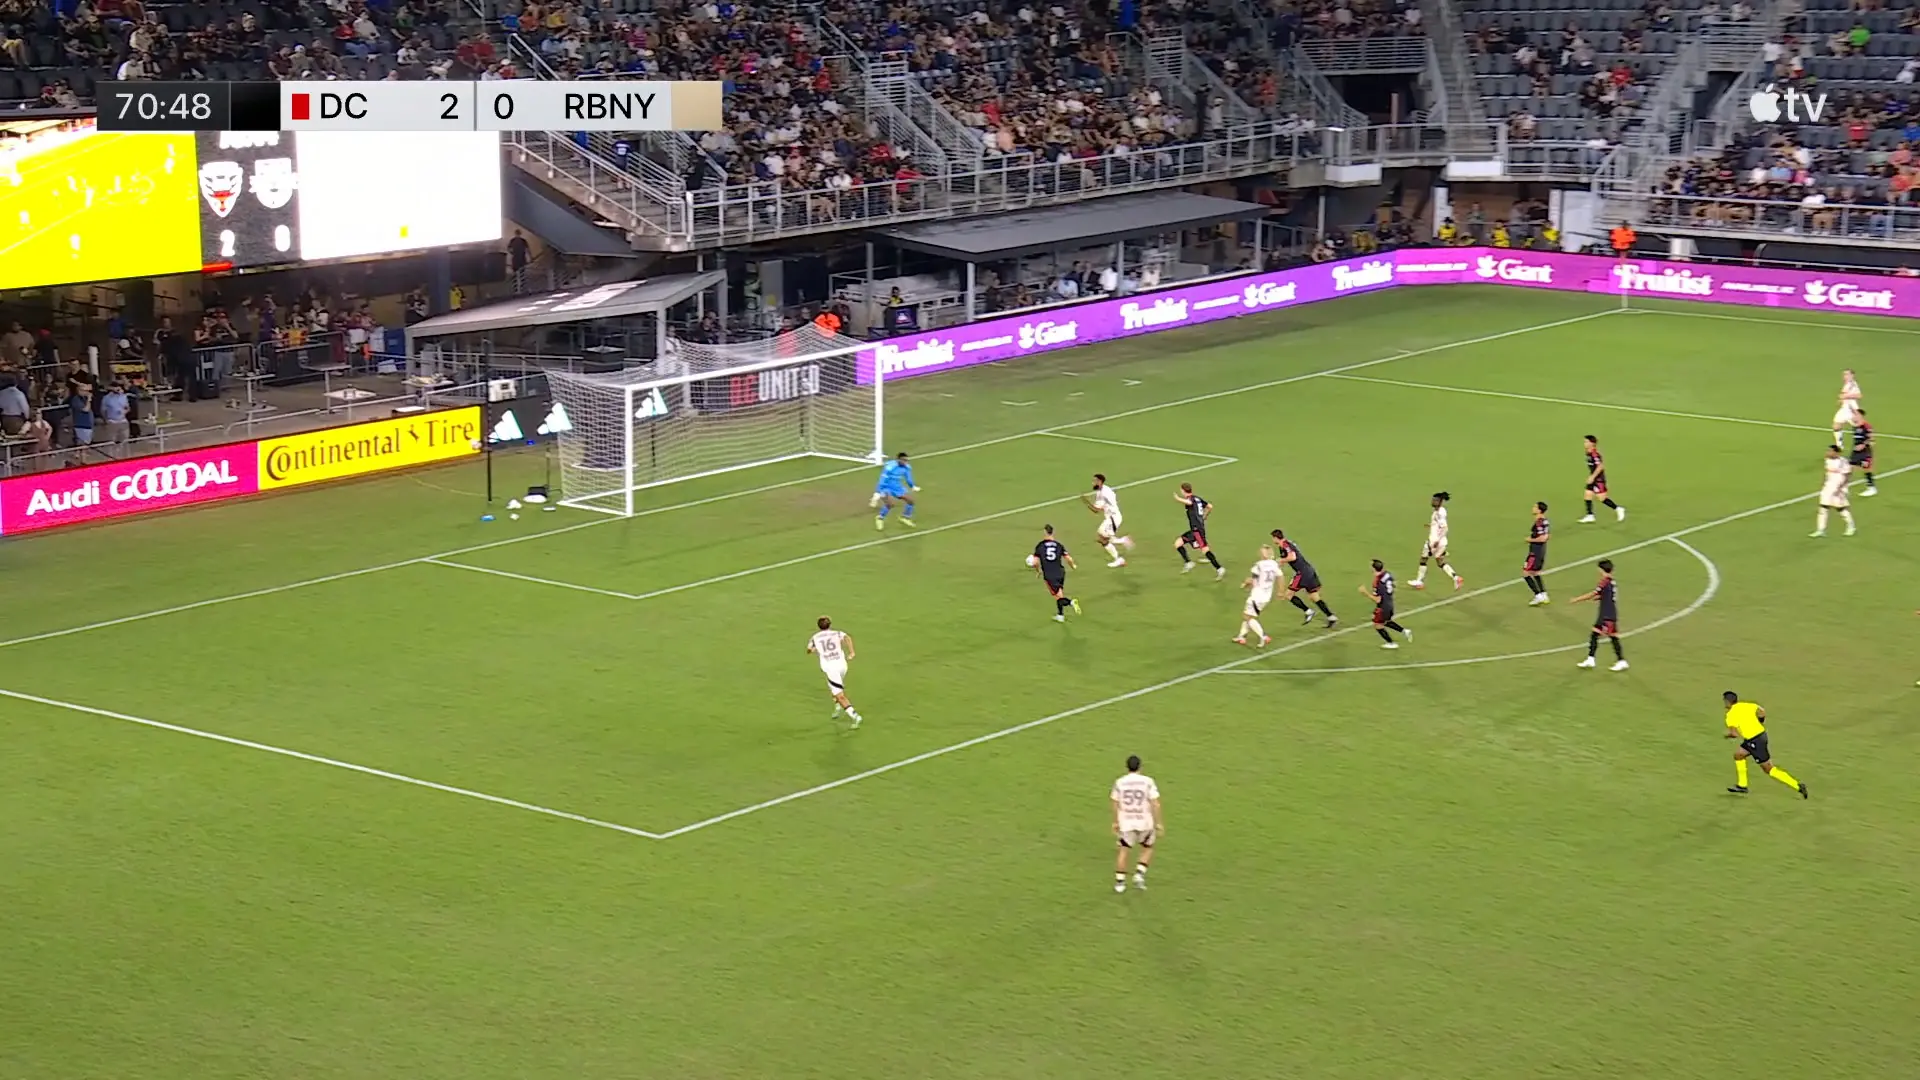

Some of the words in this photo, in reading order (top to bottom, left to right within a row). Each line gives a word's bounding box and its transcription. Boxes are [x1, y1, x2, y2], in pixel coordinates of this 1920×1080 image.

[220, 229, 236, 257] 2
[1498, 258, 1554, 283] Giant
[1612, 264, 1714, 295] Fruitist
[1827, 282, 1896, 309] Giant
[758, 364, 820, 402] UNITED
[266, 427, 401, 481] Continental
[425, 419, 474, 449] Tire
[26, 480, 100, 515] Audi
[1045, 547, 1057, 561] 5
[819, 639, 836, 652] 16
[1122, 789, 1145, 806] 59
